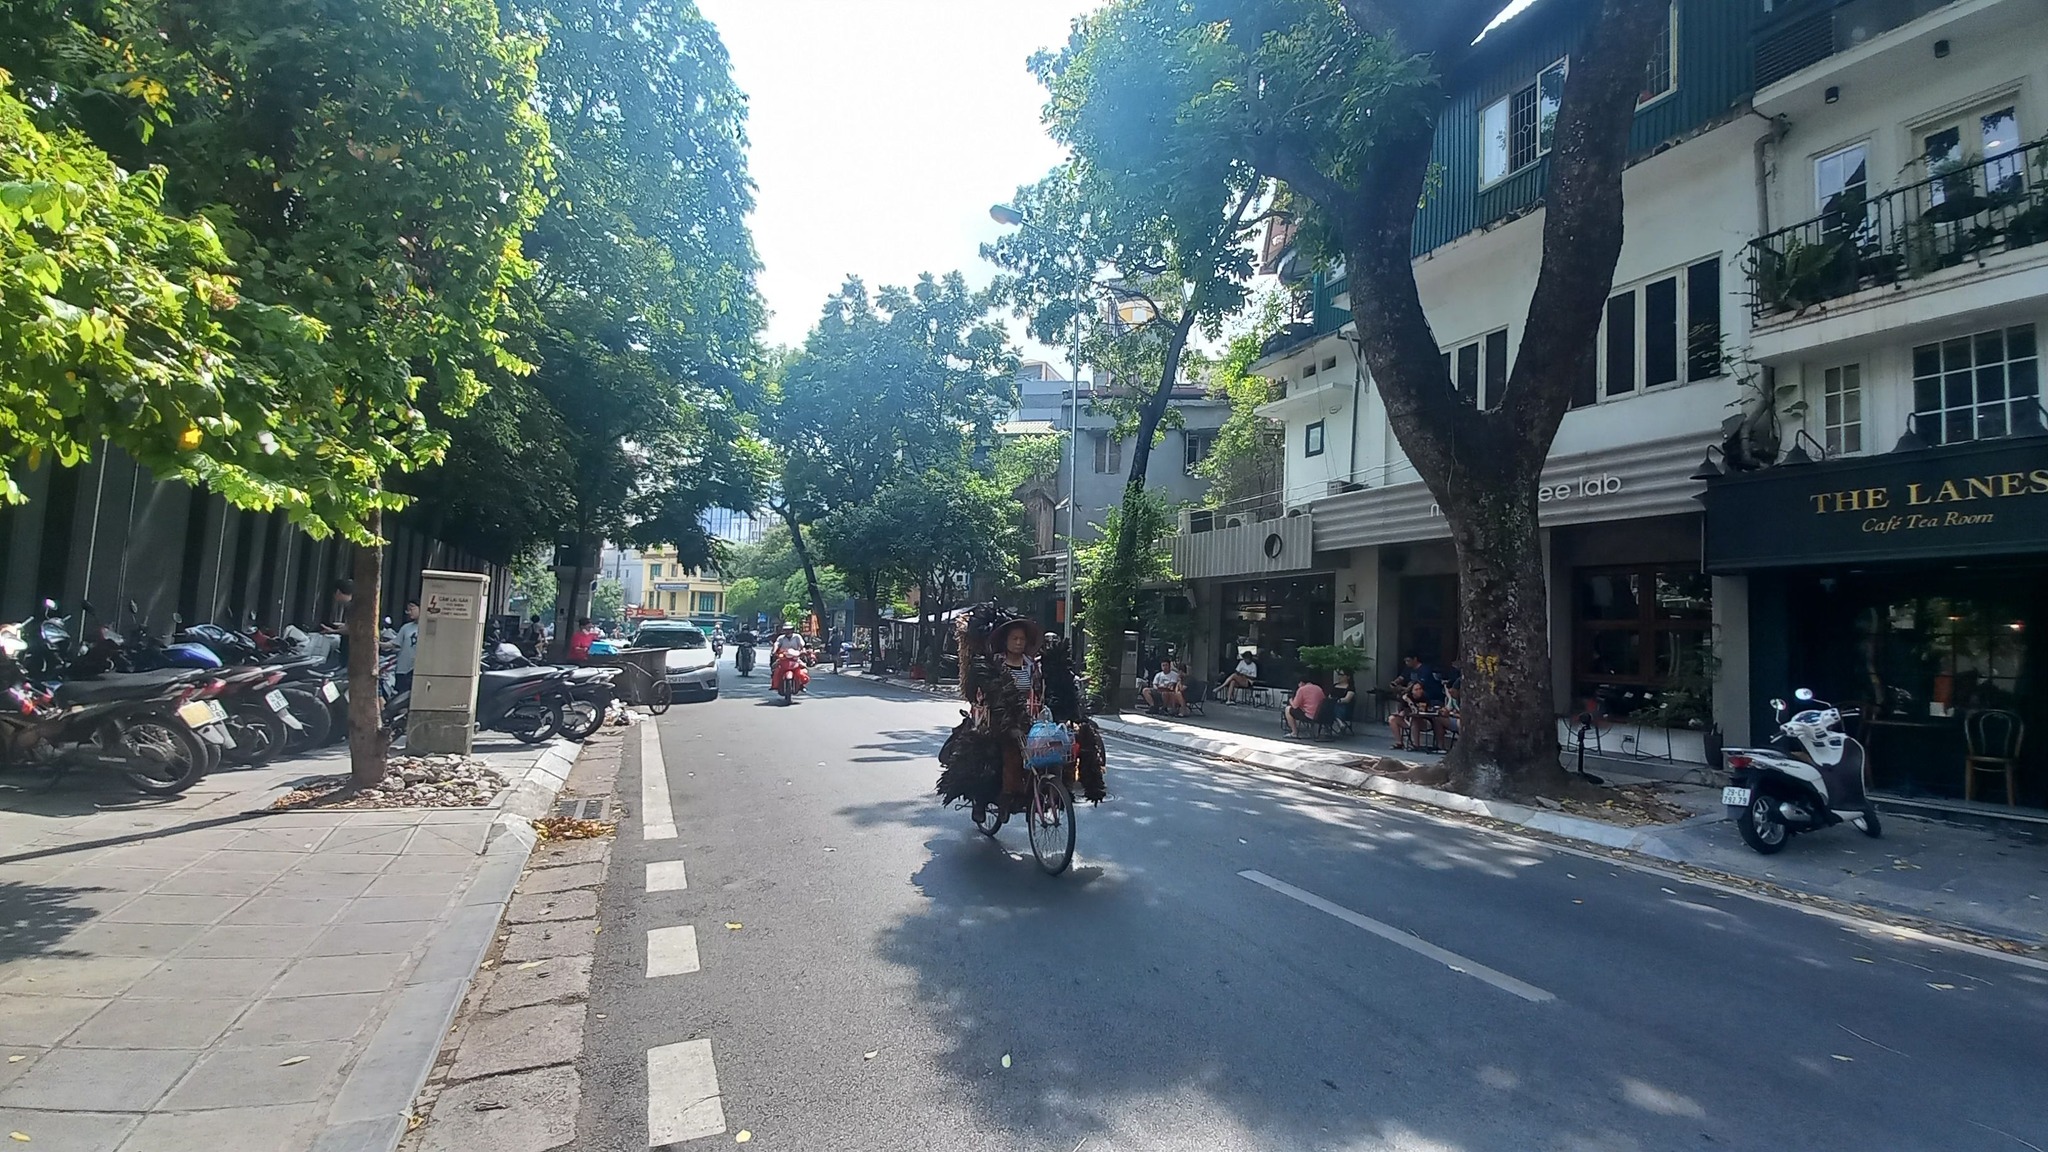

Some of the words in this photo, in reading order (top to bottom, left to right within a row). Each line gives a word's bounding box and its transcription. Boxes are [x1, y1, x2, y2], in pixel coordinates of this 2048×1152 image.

[1579, 473, 1622, 498] lab
[1809, 487, 1890, 515] THE
[1906, 469, 2048, 506] LANES
[1862, 516, 1903, 534] Café
[1905, 514, 1938, 529] Tea
[1943, 511, 1994, 526] Room
